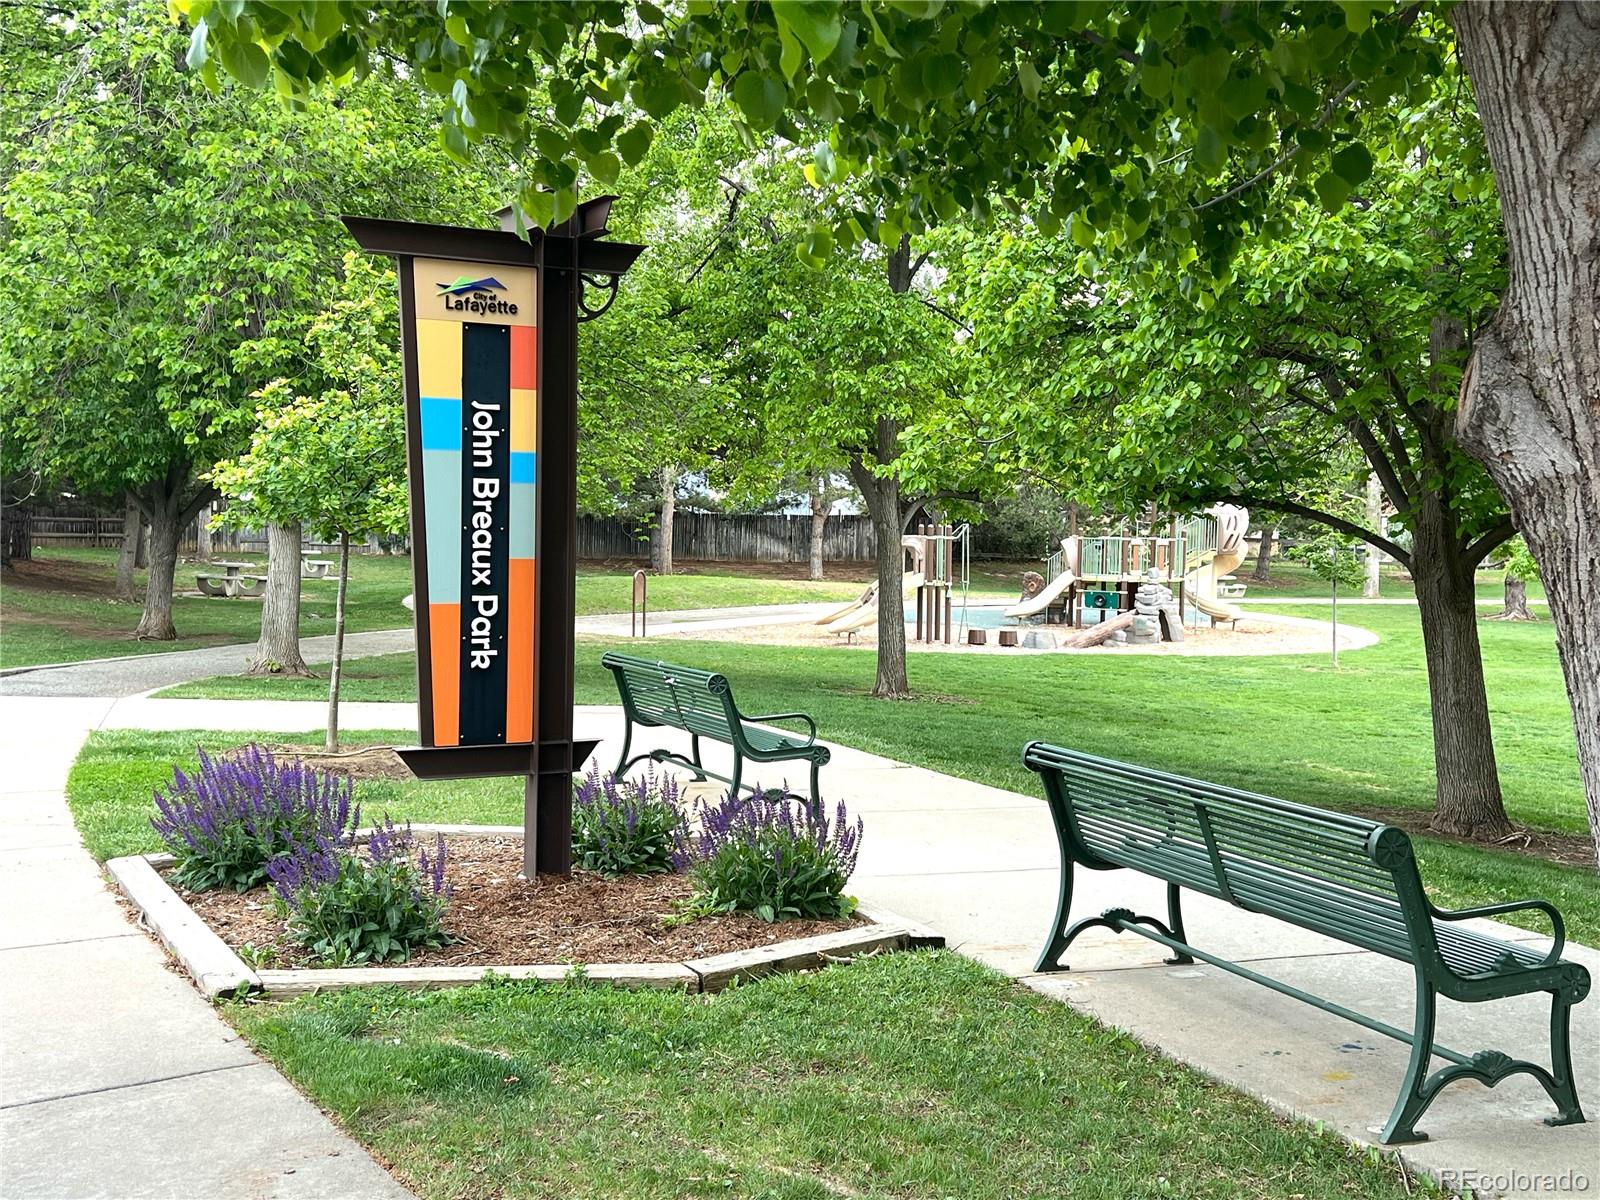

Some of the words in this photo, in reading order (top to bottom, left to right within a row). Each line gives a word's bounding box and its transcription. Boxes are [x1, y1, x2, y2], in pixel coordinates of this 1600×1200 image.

[445, 295, 518, 315] Lafayette
[473, 292, 488, 301] City
[471, 400, 500, 468] John
[471, 477, 500, 586] Breaux
[470, 594, 499, 670] Park
